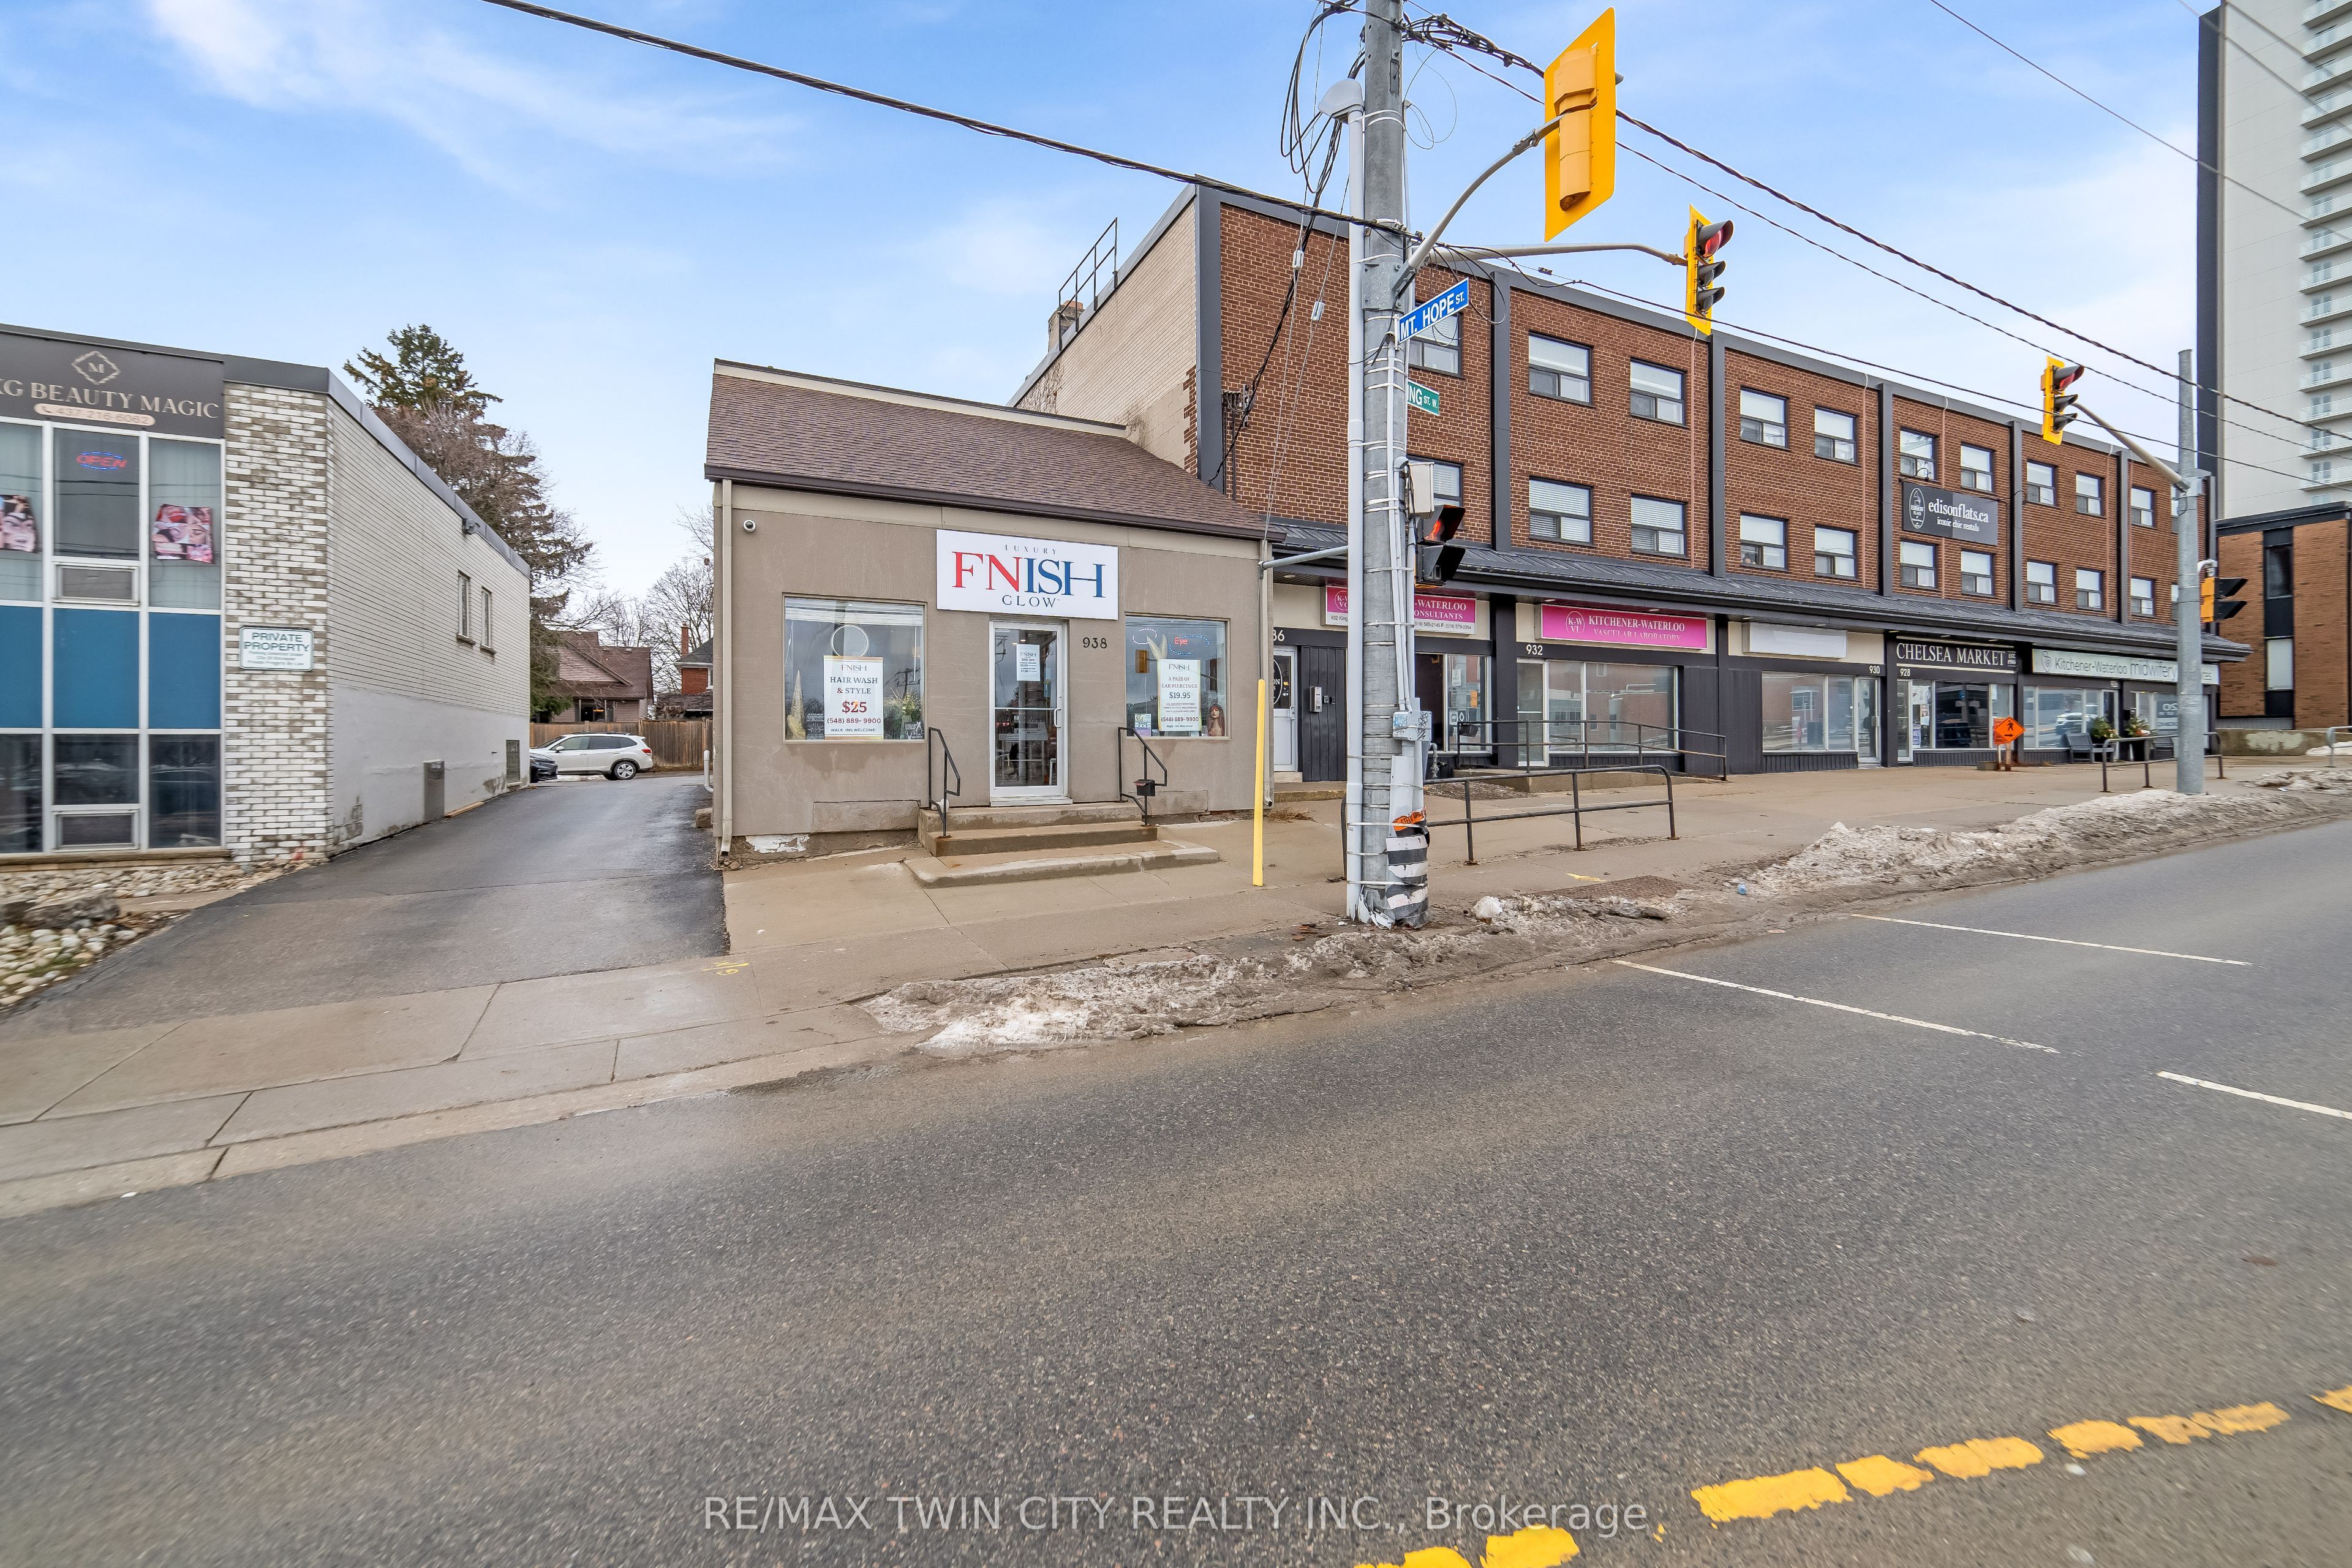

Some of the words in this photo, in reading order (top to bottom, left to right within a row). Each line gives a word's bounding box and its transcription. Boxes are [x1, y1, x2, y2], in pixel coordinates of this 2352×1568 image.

[1400, 315, 1417, 339] MT.
[1422, 293, 1455, 327] HOPE
[1455, 291, 1465, 305] ST.
[31, 382, 134, 409] BEAUTY
[140, 394, 220, 418] MAGIC
[1409, 385, 1423, 405] NG
[1432, 398, 1438, 409] W.
[76, 455, 128, 469] OPEN
[1928, 498, 1989, 523] edisonflats.ca
[1005, 544, 1057, 555] LUXURY
[951, 551, 1106, 598] FNISH
[1002, 595, 1057, 608] GLOW
[1415, 599, 1467, 611] -WATERLOO
[1414, 609, 1463, 620] ONSULTANTS
[1568, 617, 1583, 625] K-W
[1589, 615, 1685, 631] KITCHENER-WATERLOO
[252, 632, 303, 642] PRIVATE
[1174, 637, 1188, 646] Eye
[1273, 629, 1285, 642] 36
[244, 641, 310, 652] PROPERTY
[1082, 636, 1107, 649] 938
[1526, 644, 1544, 656] 932
[1896, 643, 1952, 663] CHELSEA
[1956, 647, 2005, 666] MARKET
[1869, 665, 1880, 674] 930
[1900, 668, 1911, 677] 928
[2055, 658, 2127, 674] Kitchener-Waterloo
[2130, 660, 2178, 680] midwifery
[842, 700, 867, 714] $25
